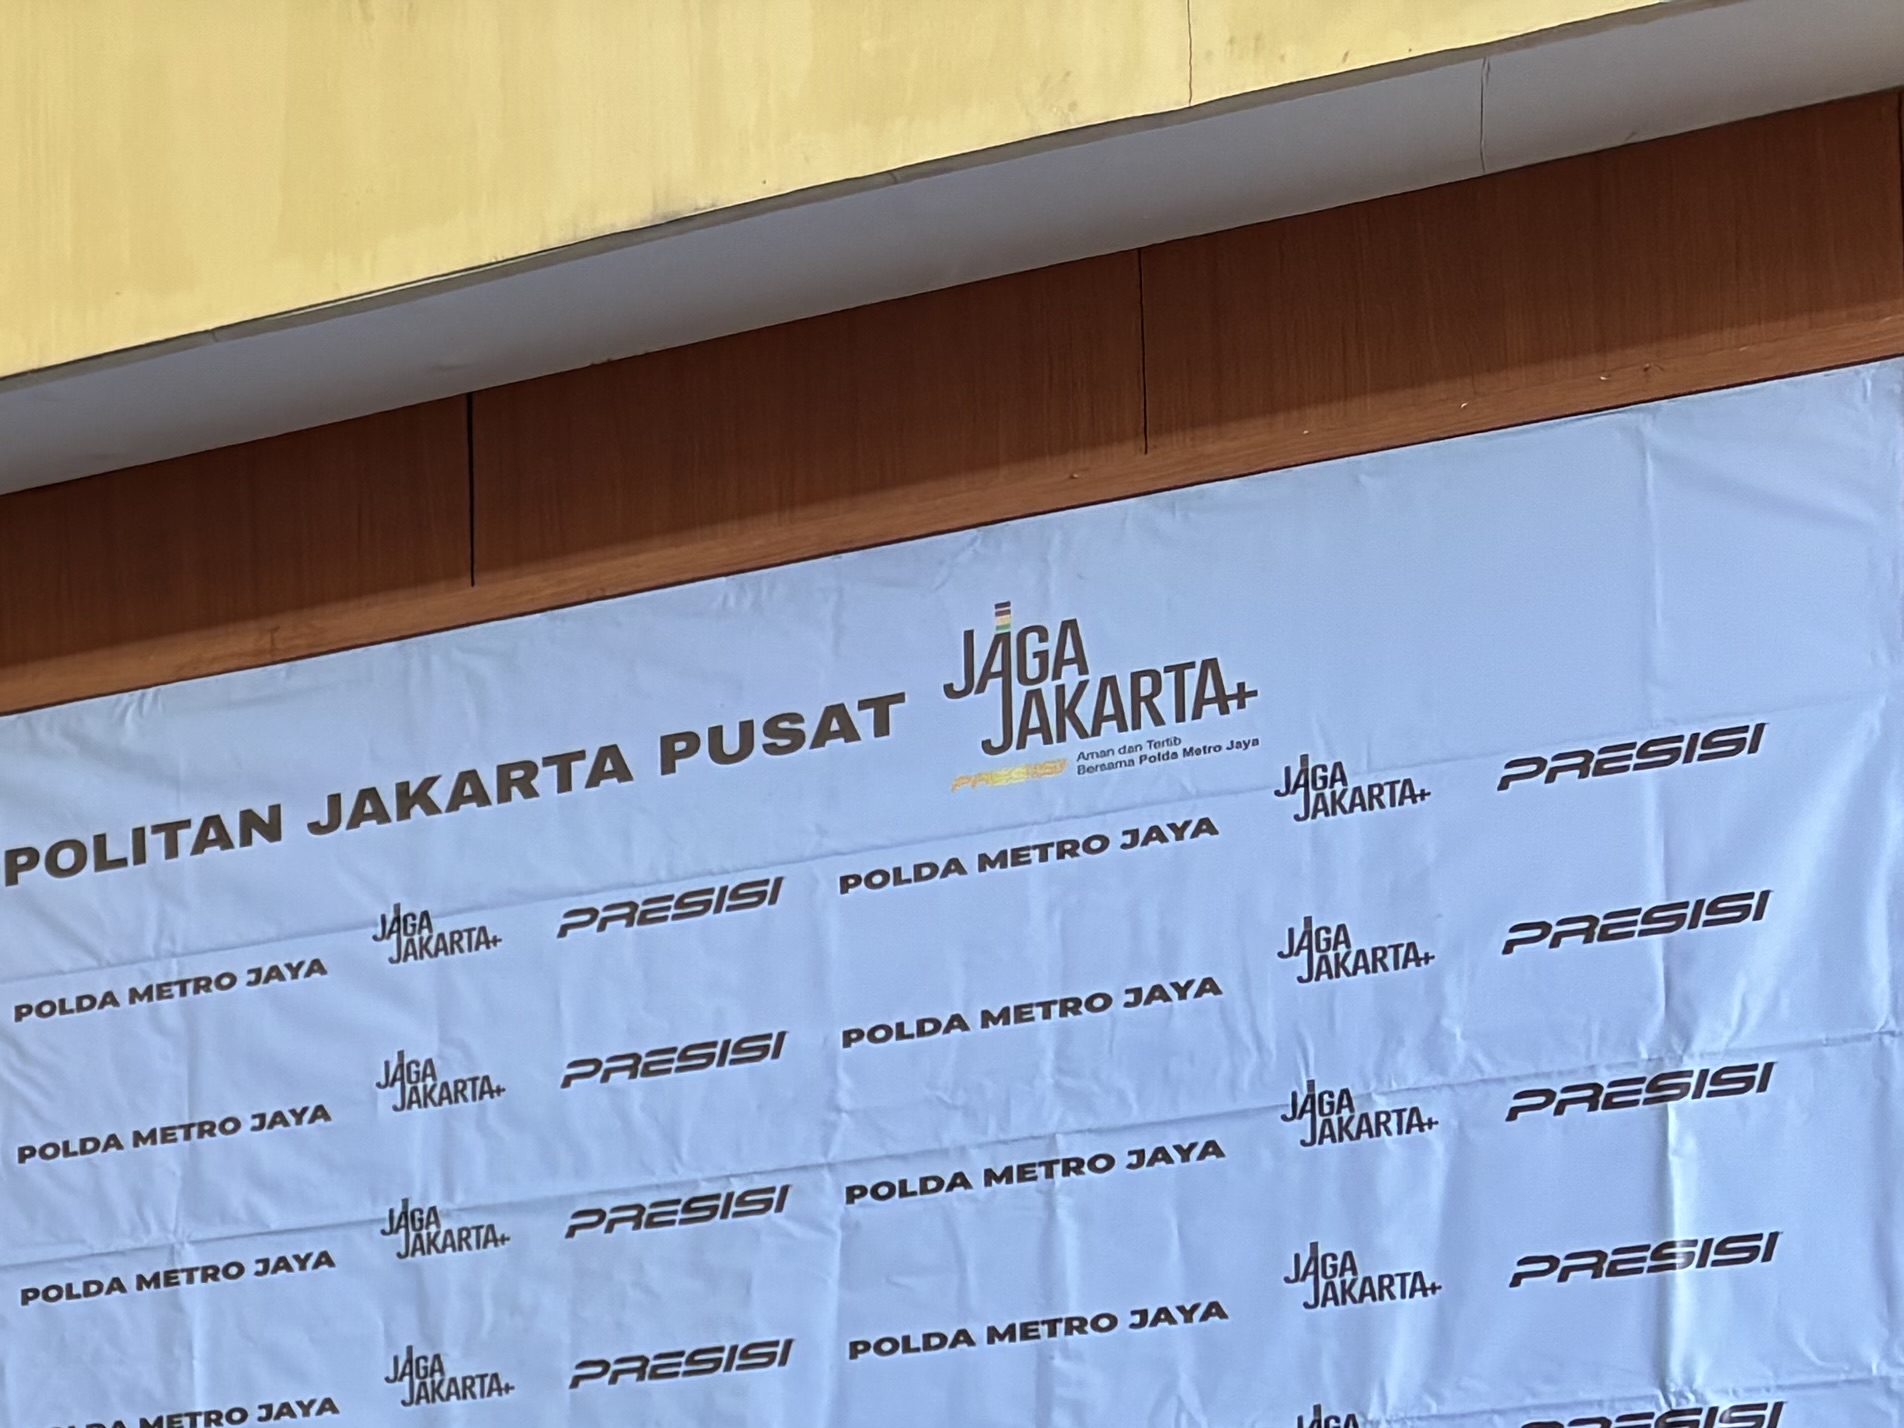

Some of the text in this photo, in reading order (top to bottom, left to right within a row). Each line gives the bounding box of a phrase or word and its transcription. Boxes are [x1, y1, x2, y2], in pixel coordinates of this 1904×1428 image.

[944, 619, 1089, 699] JAGA
[307, 744, 633, 835] JAKARTA
[660, 692, 905, 775] PUSAT
[1077, 749, 1115, 762] Aman
[1118, 744, 1143, 755] dan
[1077, 736, 1260, 776] Bersama Polda Metro Jaya
[1274, 754, 1347, 796] JAGA
[1497, 723, 1768, 791] PRESISI
[840, 817, 1219, 894] POLDA METRO JAYA
[372, 903, 432, 941] JAGA
[557, 877, 784, 938] PRESISI
[15, 959, 327, 1022] POLDA METRO JAYA
[1281, 1080, 1354, 1122] JAGA
[1505, 1062, 1776, 1121] PRESISI
[846, 1140, 1225, 1204] POLDA METRO JAYA
[381, 1198, 441, 1236] JAGA
[565, 1185, 790, 1238] PRESISI
[21, 1251, 335, 1306] POLDA METRO JAYA
